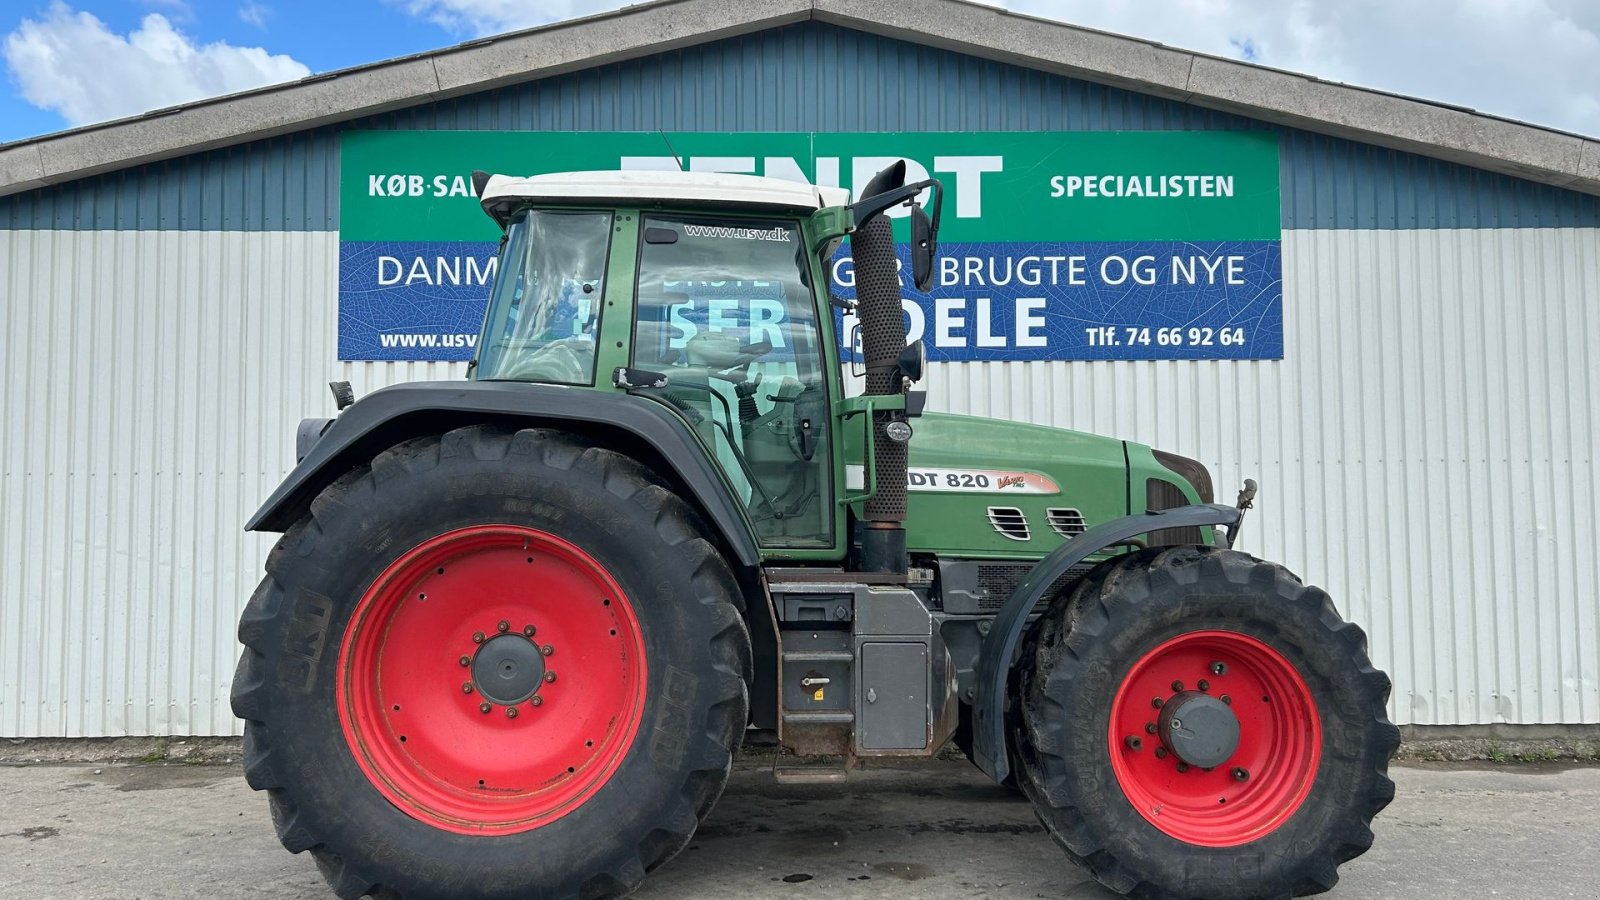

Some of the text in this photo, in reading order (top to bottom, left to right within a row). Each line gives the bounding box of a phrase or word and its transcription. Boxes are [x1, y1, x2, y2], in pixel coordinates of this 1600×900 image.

[1050, 175, 1234, 197] SPECIALISTEN
[684, 225, 790, 242] www.usv.dk
[378, 256, 498, 285] DANM
[940, 256, 1245, 286] BRUGTE OG NYE
[380, 334, 478, 348] www.usv
[1086, 327, 1245, 346] Tlf. 74 66 92 64
[946, 474, 990, 488] 820
